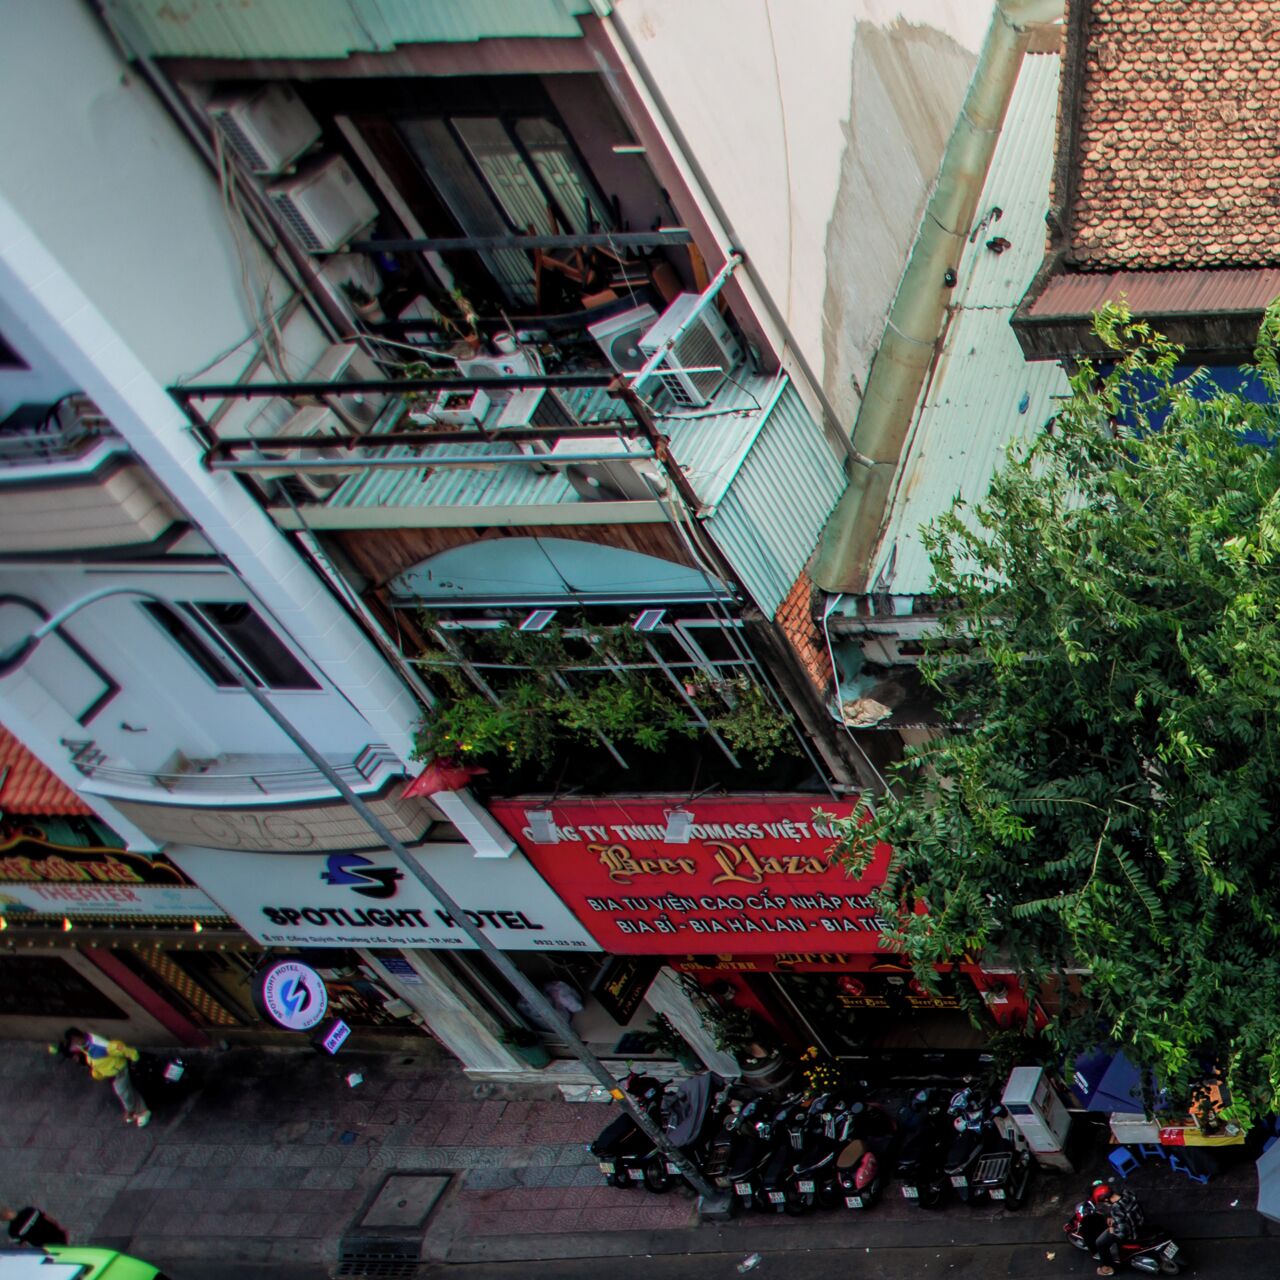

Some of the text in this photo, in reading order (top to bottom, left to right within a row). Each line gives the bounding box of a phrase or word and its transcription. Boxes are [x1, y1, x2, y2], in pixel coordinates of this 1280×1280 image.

[522, 825, 582, 842] CNG
[578, 825, 610, 841] TY
[587, 840, 830, 886] Beer Plaza
[586, 898, 623, 912] BIA
[700, 897, 744, 910] CAO
[262, 907, 429, 927] SPOTLIGHT
[616, 920, 655, 934] BIA
[688, 919, 727, 933] BIA
[727, 914, 762, 933] HÀ
[761, 918, 808, 933] LAN
[820, 919, 860, 932] BIA
